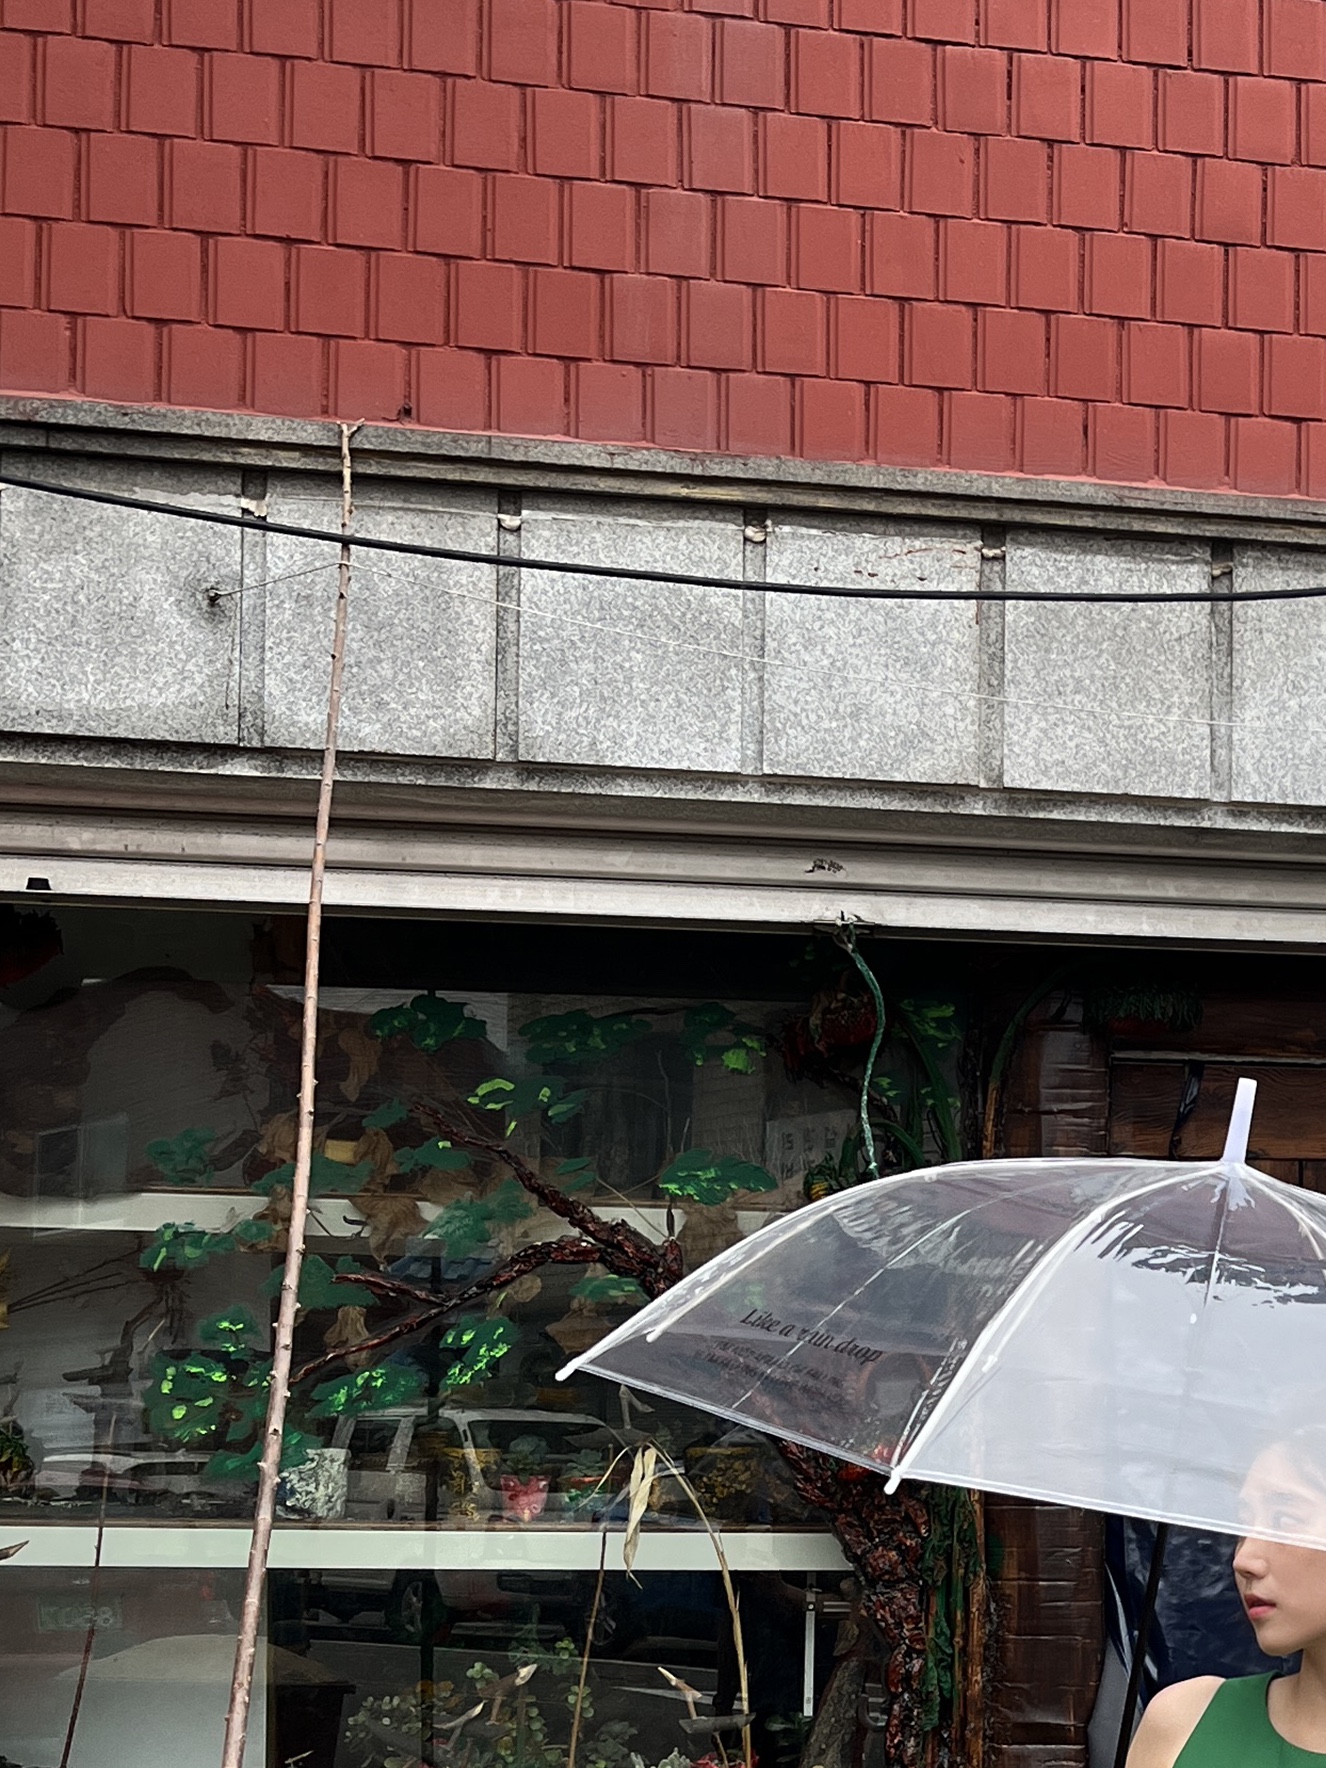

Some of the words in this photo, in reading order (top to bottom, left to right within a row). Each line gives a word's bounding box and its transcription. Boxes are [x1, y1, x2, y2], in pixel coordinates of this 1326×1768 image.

[740, 1308, 781, 1332] Like
[779, 1324, 796, 1337] a
[833, 1337, 884, 1366] drop
